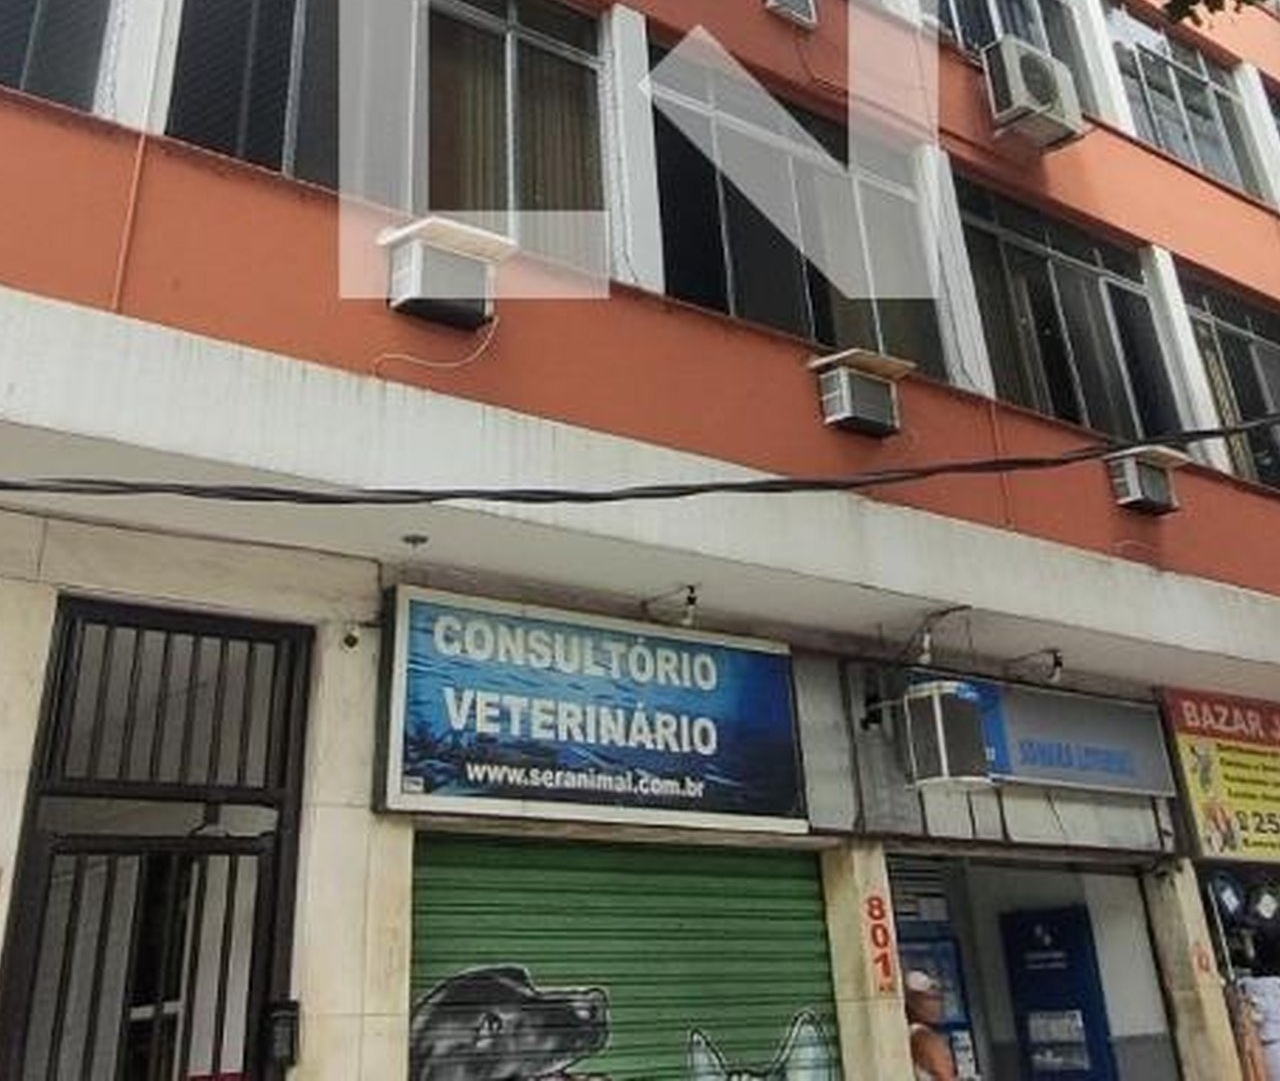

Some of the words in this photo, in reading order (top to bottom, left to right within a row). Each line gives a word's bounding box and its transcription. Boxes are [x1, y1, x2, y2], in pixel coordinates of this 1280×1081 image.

[431, 616, 719, 691] CONSULTÓRIO
[443, 687, 719, 756] VETERINÁRIO
[1181, 699, 1264, 739] BAZAR
[466, 760, 705, 799] www.seranimal.com.br
[867, 896, 891, 978] 801
